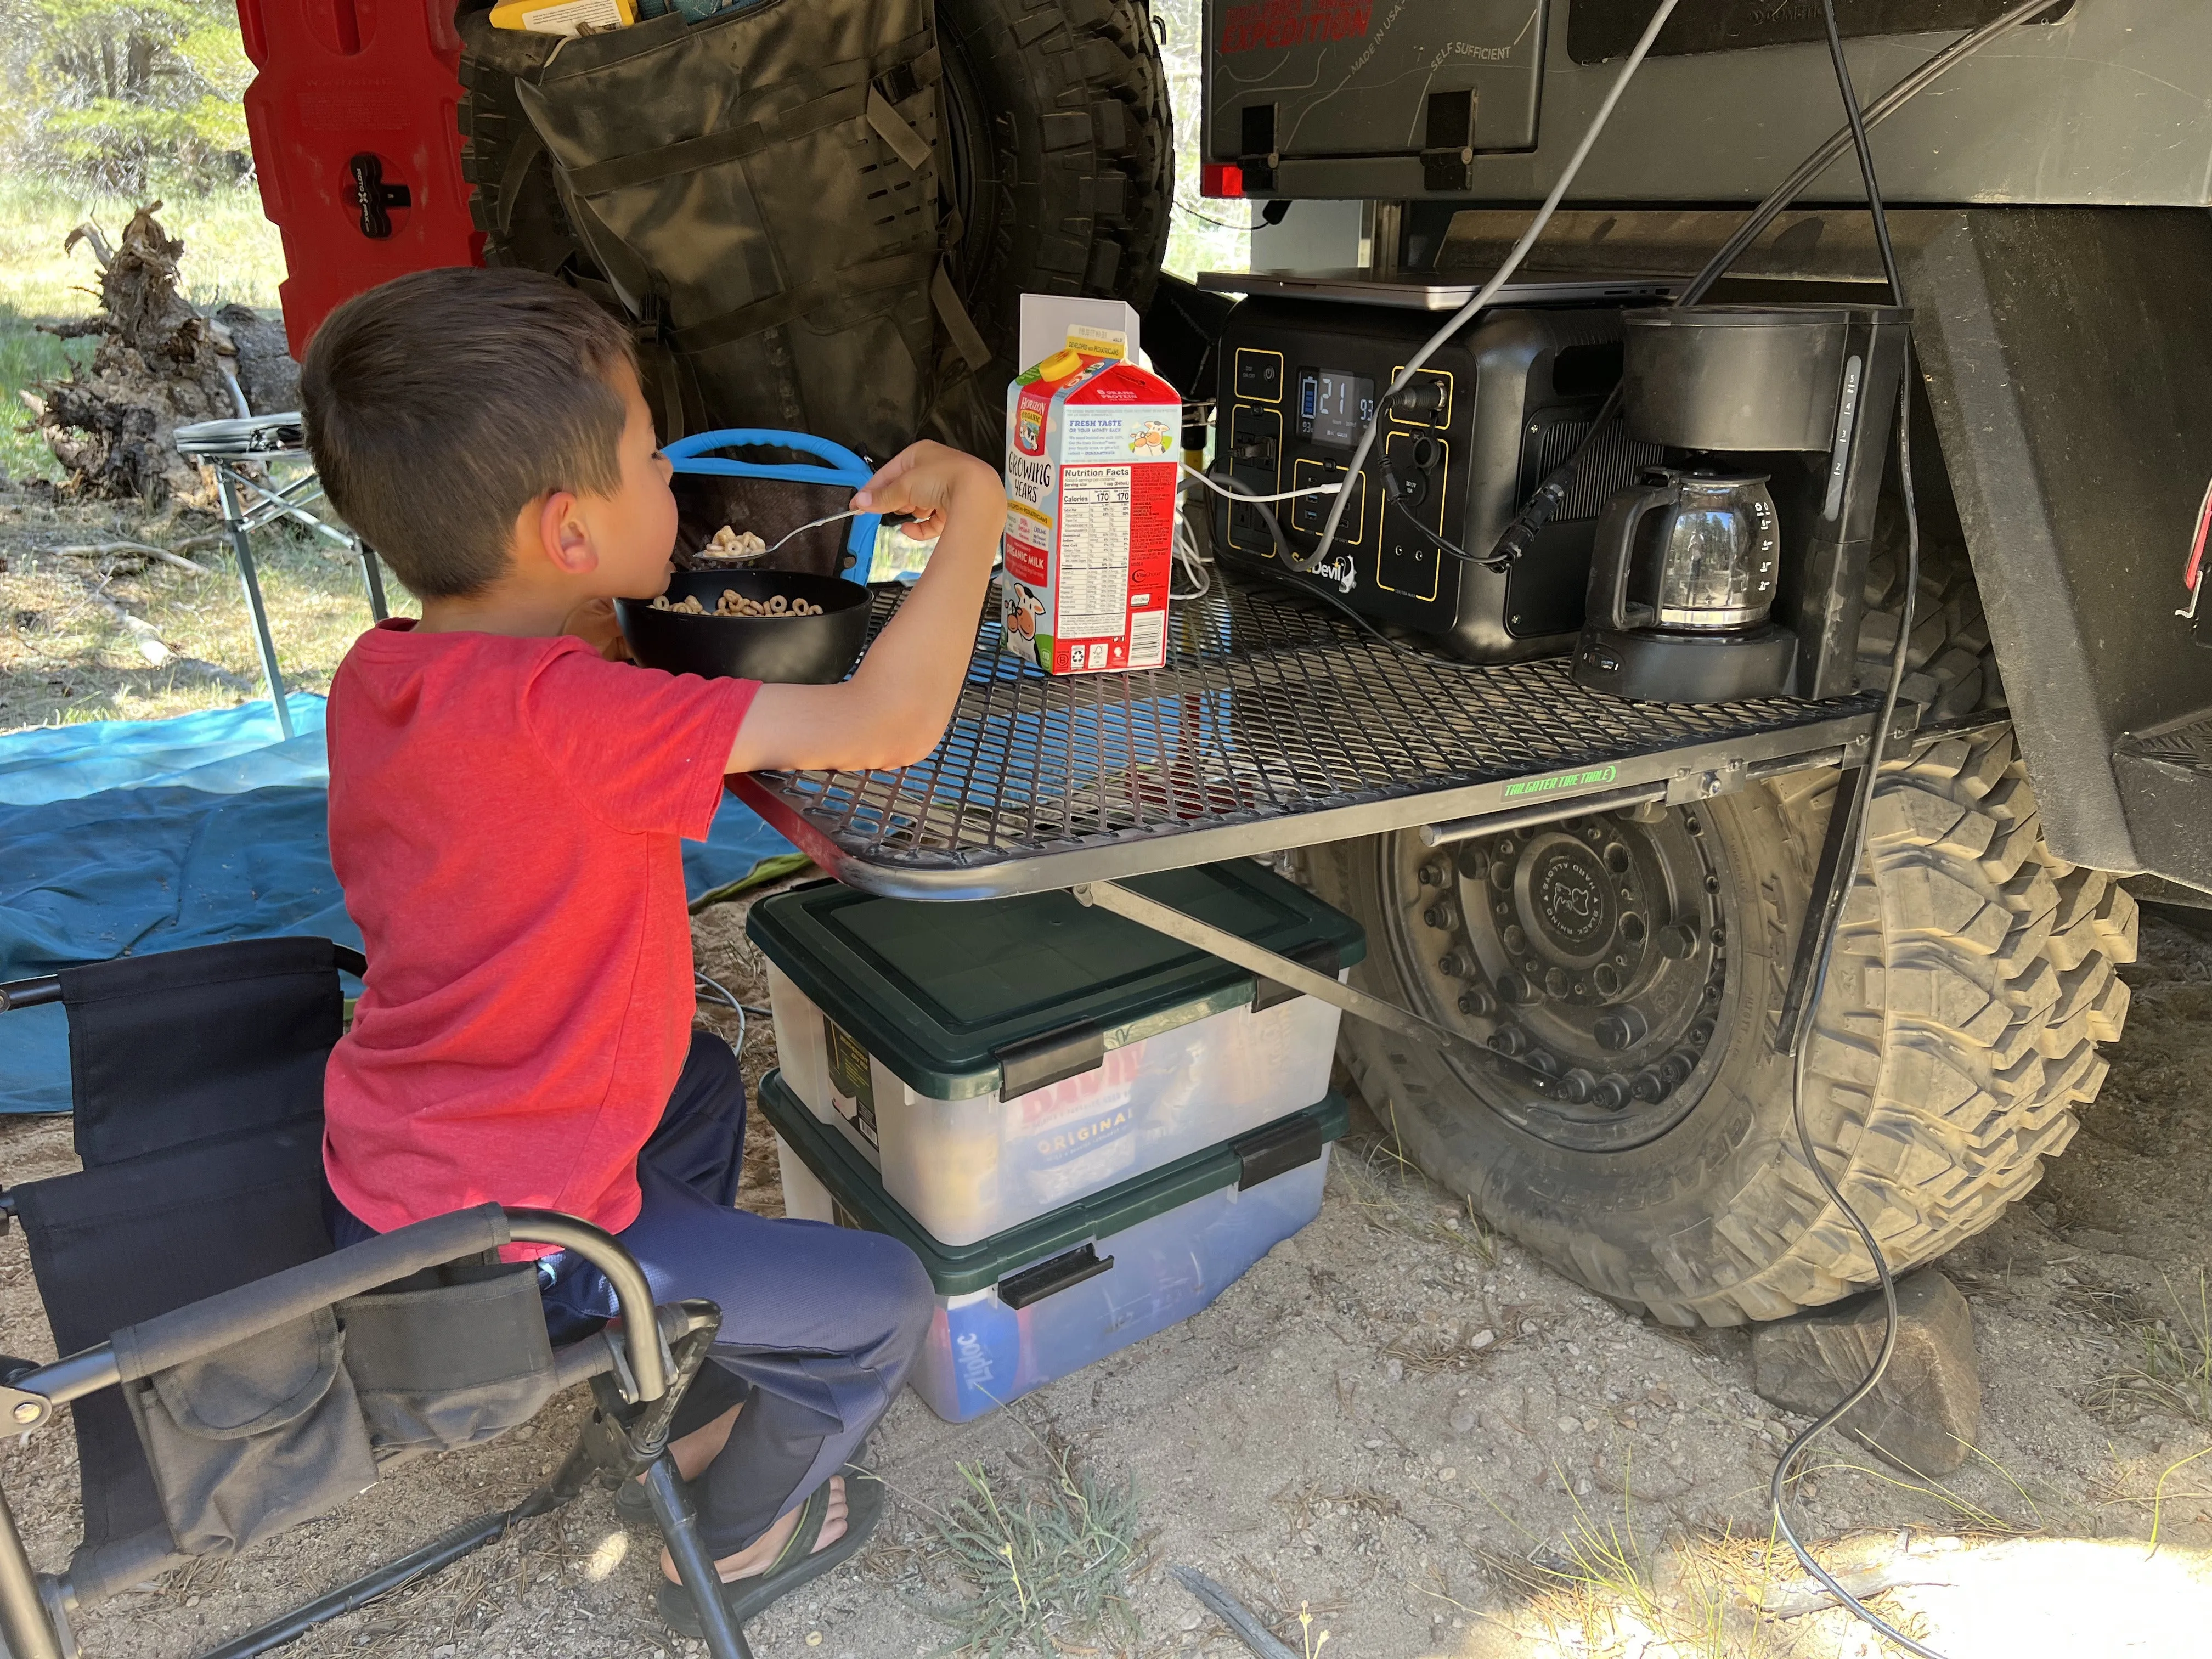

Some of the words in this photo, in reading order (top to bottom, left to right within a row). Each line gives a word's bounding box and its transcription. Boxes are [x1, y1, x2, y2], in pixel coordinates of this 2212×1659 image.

[1220, 7, 1373, 53] EXPEDITION
[1350, 43, 1376, 75] MADE
[1374, 29, 1384, 45] IN
[1430, 42, 1453, 71] SELF
[1454, 41, 1511, 60] SUFFICIENT
[1068, 341, 1088, 351] DEVELOPED
[1850, 374, 1855, 382] 5
[1020, 397, 1046, 415] HORIZON
[1022, 411, 1041, 423] ORGANIC
[1846, 402, 1852, 410] 4
[1008, 451, 1051, 487] GROWING
[1015, 479, 1037, 503] YEARS
[1006, 543, 1028, 563] ORGANIC
[1028, 555, 1045, 569] MILK
[1505, 777, 1558, 797] TAILGATER
[1558, 774, 1581, 788] TIRE
[1580, 769, 1611, 785] TABLE
[1543, 862, 1568, 890] ALLOYS
[1572, 864, 1595, 890] HARD
[1547, 908, 1573, 935] RHINO
[1577, 910, 1598, 935] BLACK
[957, 1333, 994, 1391] Ziploc
